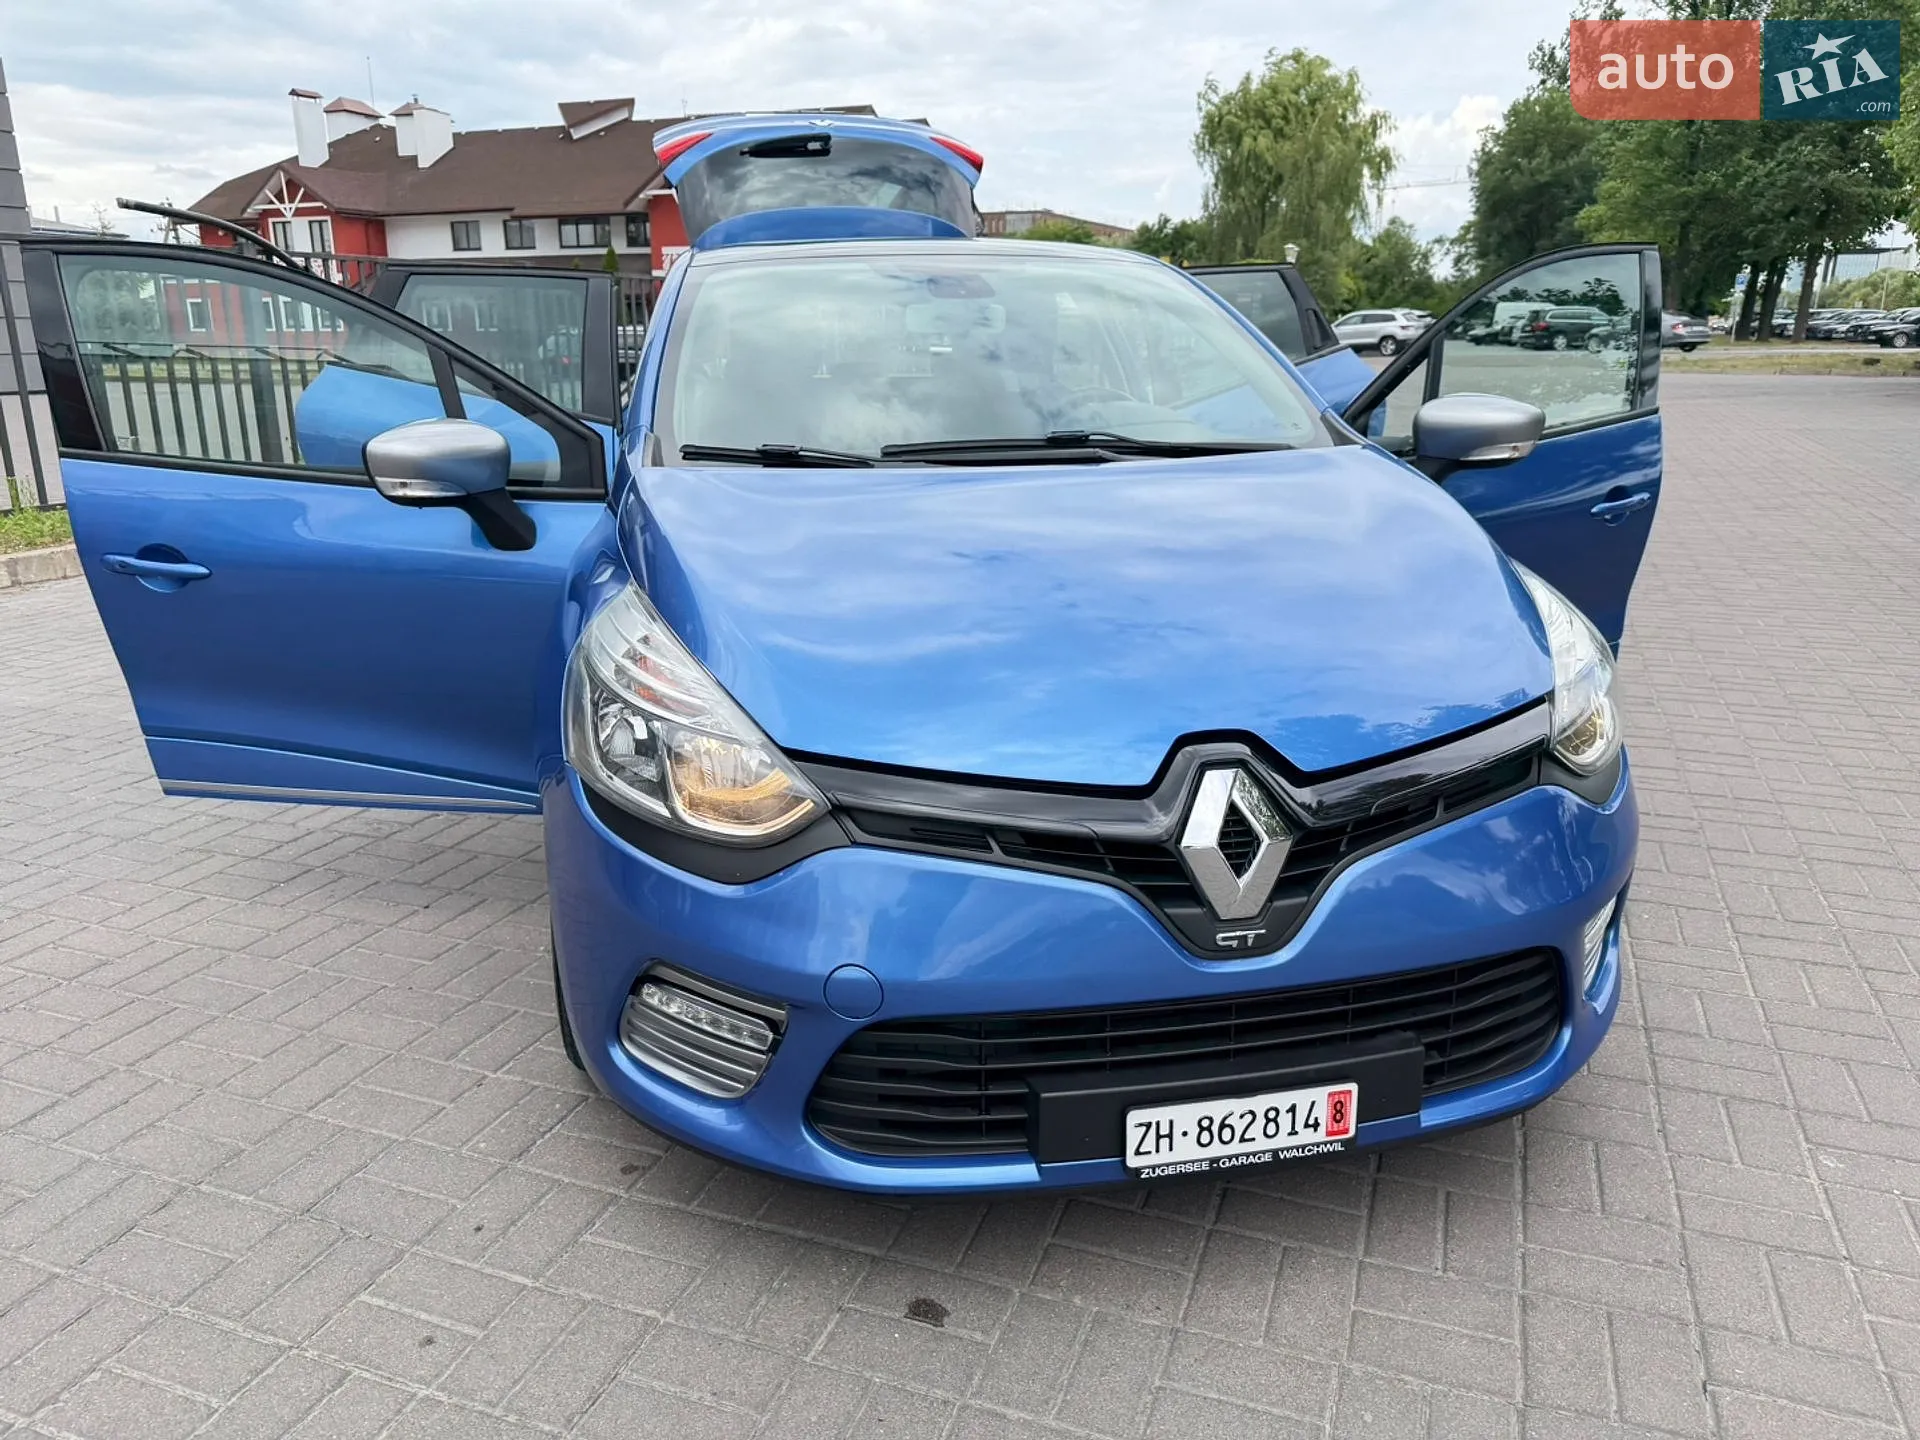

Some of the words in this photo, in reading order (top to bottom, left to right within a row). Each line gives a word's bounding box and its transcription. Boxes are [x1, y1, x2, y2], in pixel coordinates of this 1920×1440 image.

[1215, 929, 1267, 948] GT
[1332, 1100, 1345, 1124] 8
[1278, 1141, 1346, 1160] WALCHWIL
